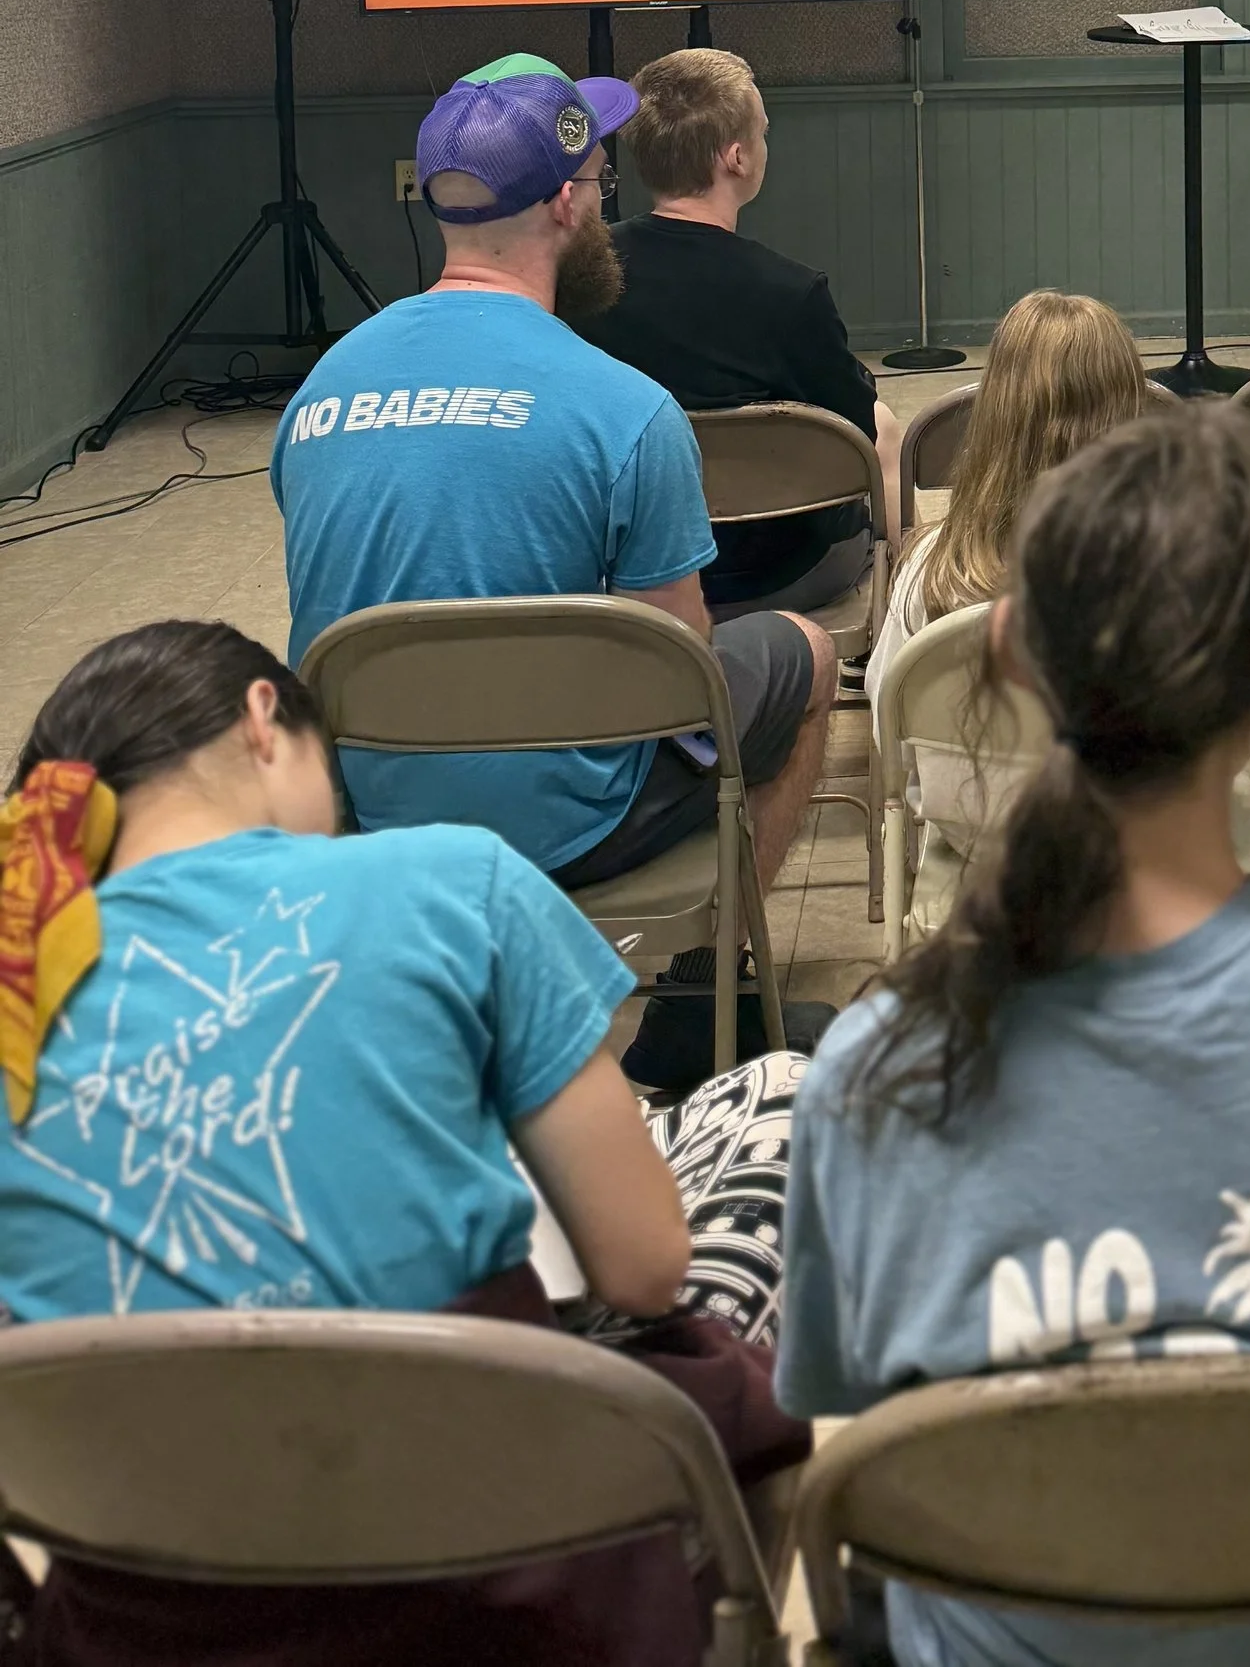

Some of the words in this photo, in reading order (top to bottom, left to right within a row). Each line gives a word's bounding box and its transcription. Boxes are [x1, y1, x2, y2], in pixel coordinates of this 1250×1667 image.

[290, 397, 342, 445] NO
[343, 387, 536, 432] BABIES
[119, 1065, 301, 1187] Lord!
[132, 1068, 235, 1131] the
[990, 1228, 1155, 1363] NO
